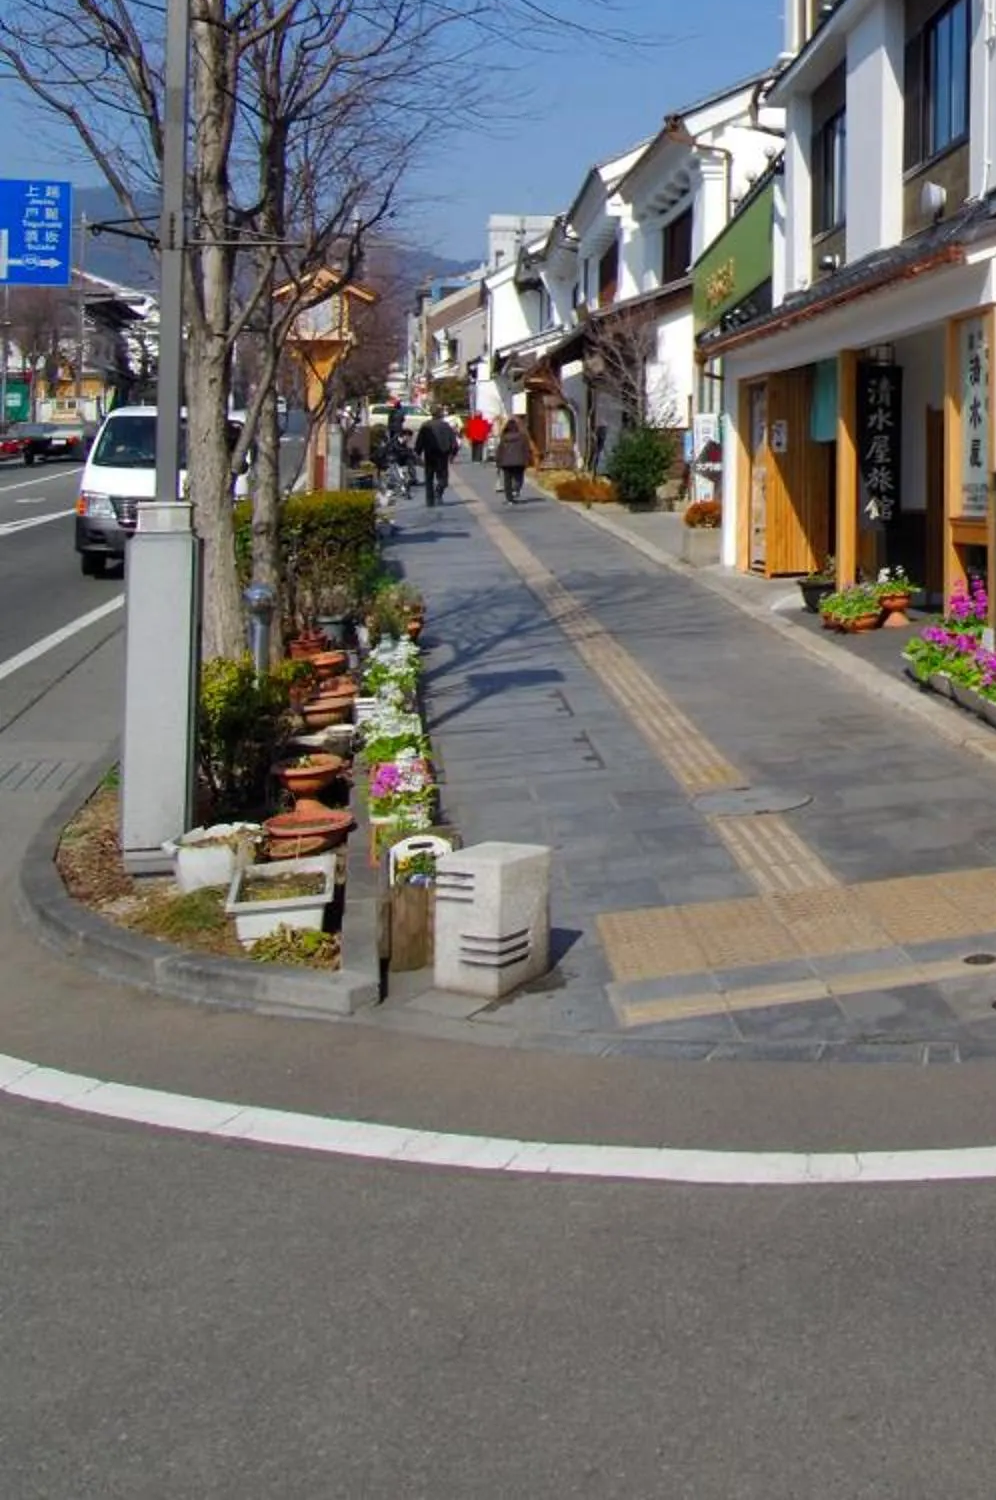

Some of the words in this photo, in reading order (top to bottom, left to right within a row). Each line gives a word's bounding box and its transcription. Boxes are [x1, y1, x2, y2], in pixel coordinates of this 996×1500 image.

[865, 375, 897, 522] 清水屋旅館
